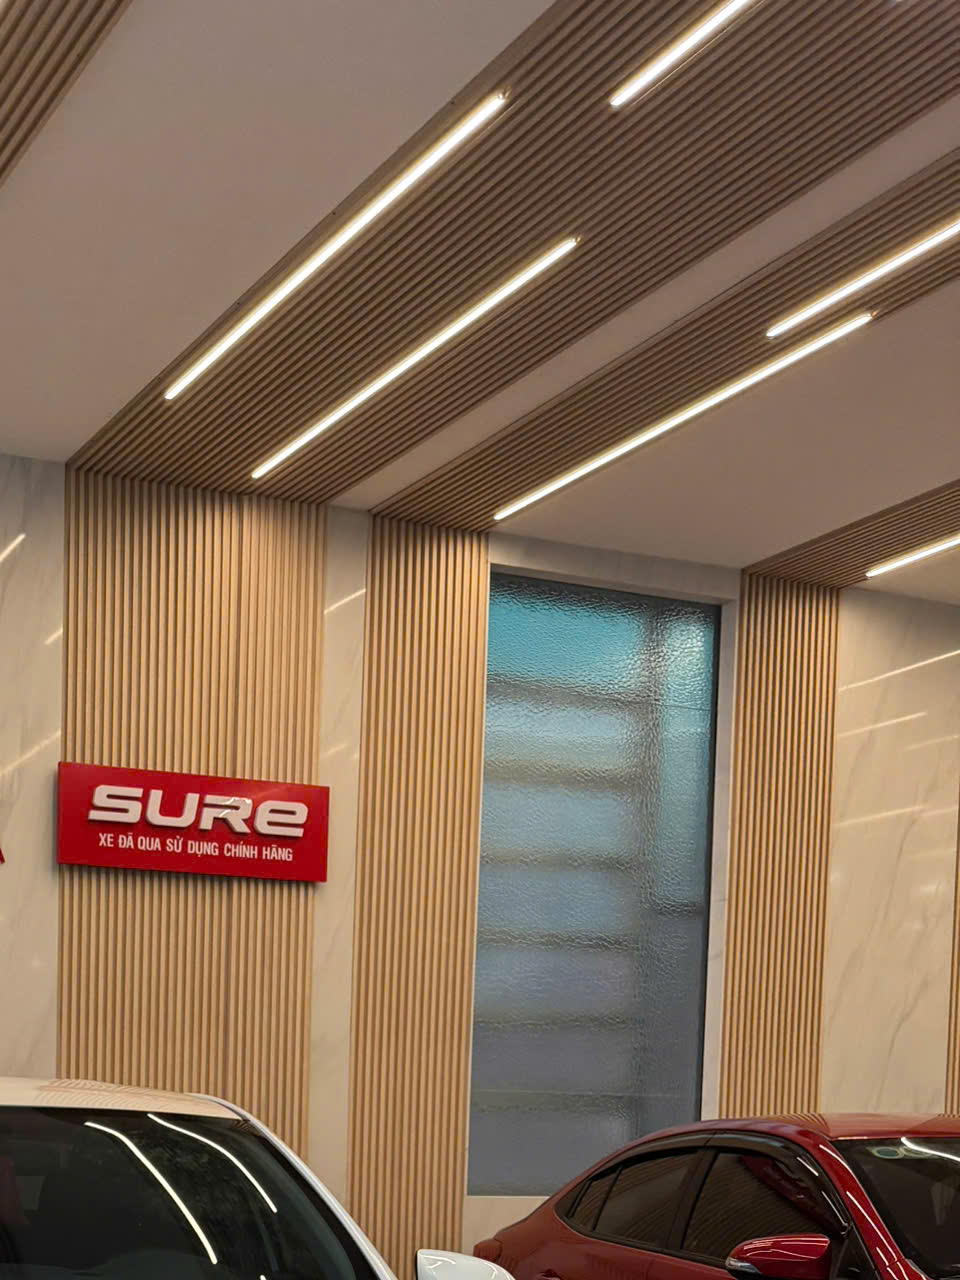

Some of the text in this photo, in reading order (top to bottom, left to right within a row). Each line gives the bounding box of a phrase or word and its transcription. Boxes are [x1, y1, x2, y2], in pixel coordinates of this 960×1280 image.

[99, 832, 114, 848] XE
[118, 832, 134, 849] ĐÃ
[137, 835, 161, 851] QUA
[166, 835, 184, 853] SỬ
[187, 840, 219, 858] DỤNG
[223, 841, 258, 859] CHÍNH
